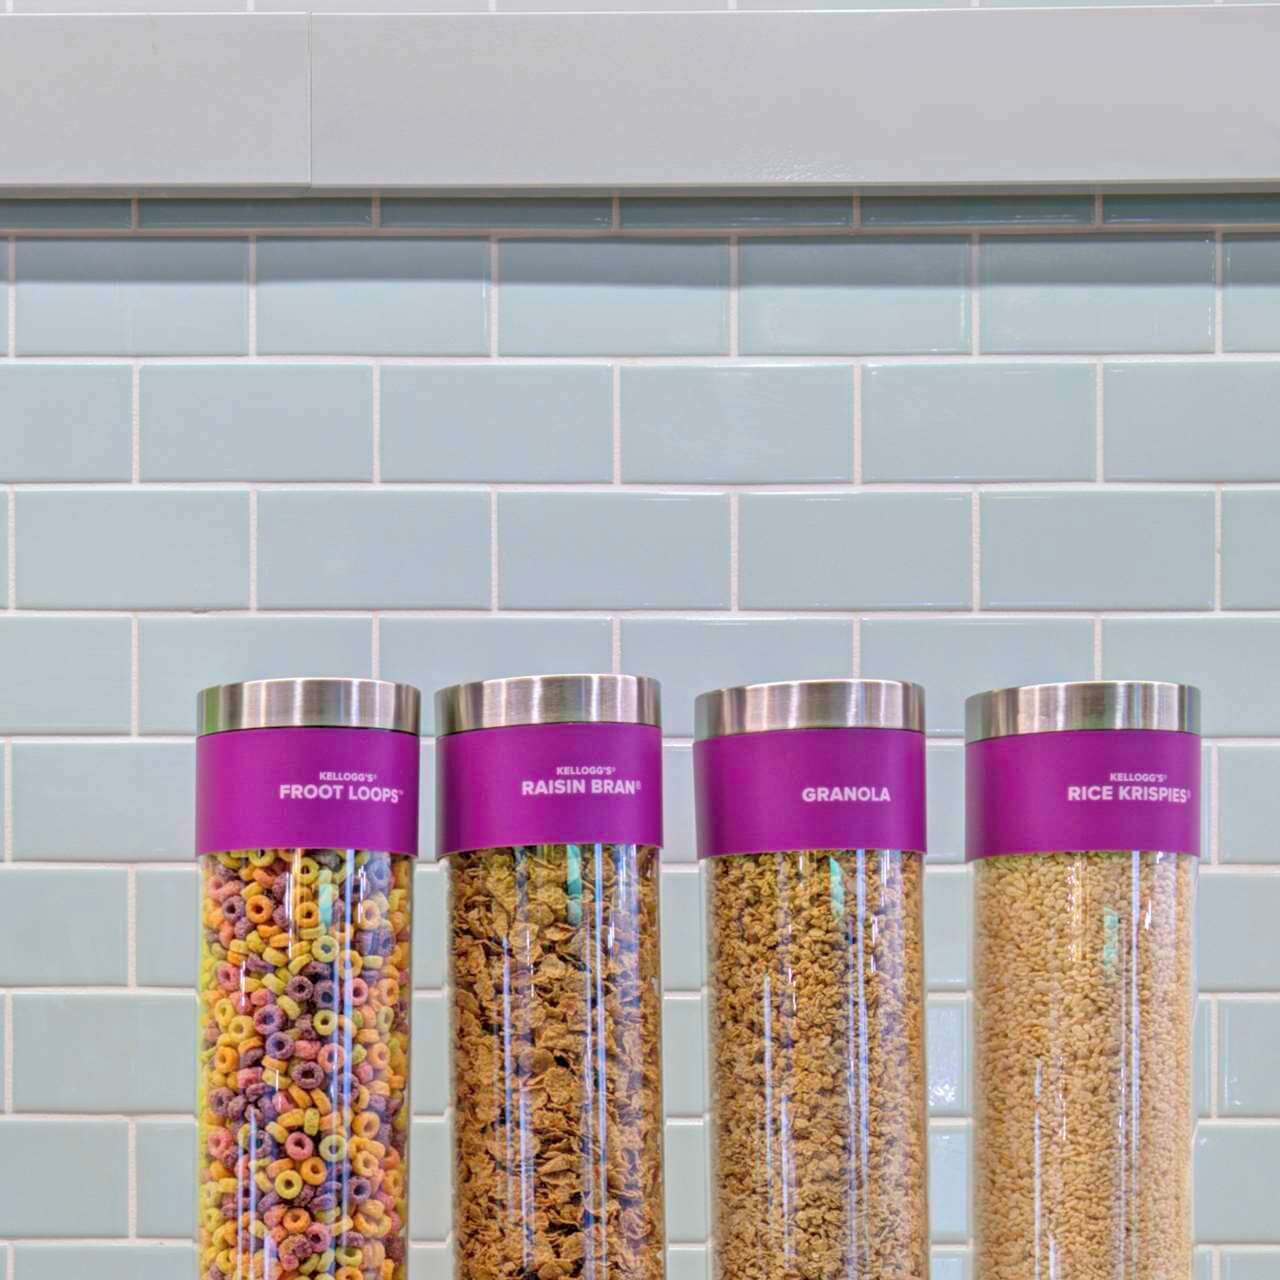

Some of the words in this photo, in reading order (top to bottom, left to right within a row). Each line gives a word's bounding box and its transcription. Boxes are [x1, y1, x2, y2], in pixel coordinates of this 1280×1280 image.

[279, 784, 344, 800] FROOT
[521, 779, 586, 795] RAISIN
[802, 786, 892, 802] GRANOLA
[1067, 786, 1113, 801] RICE
